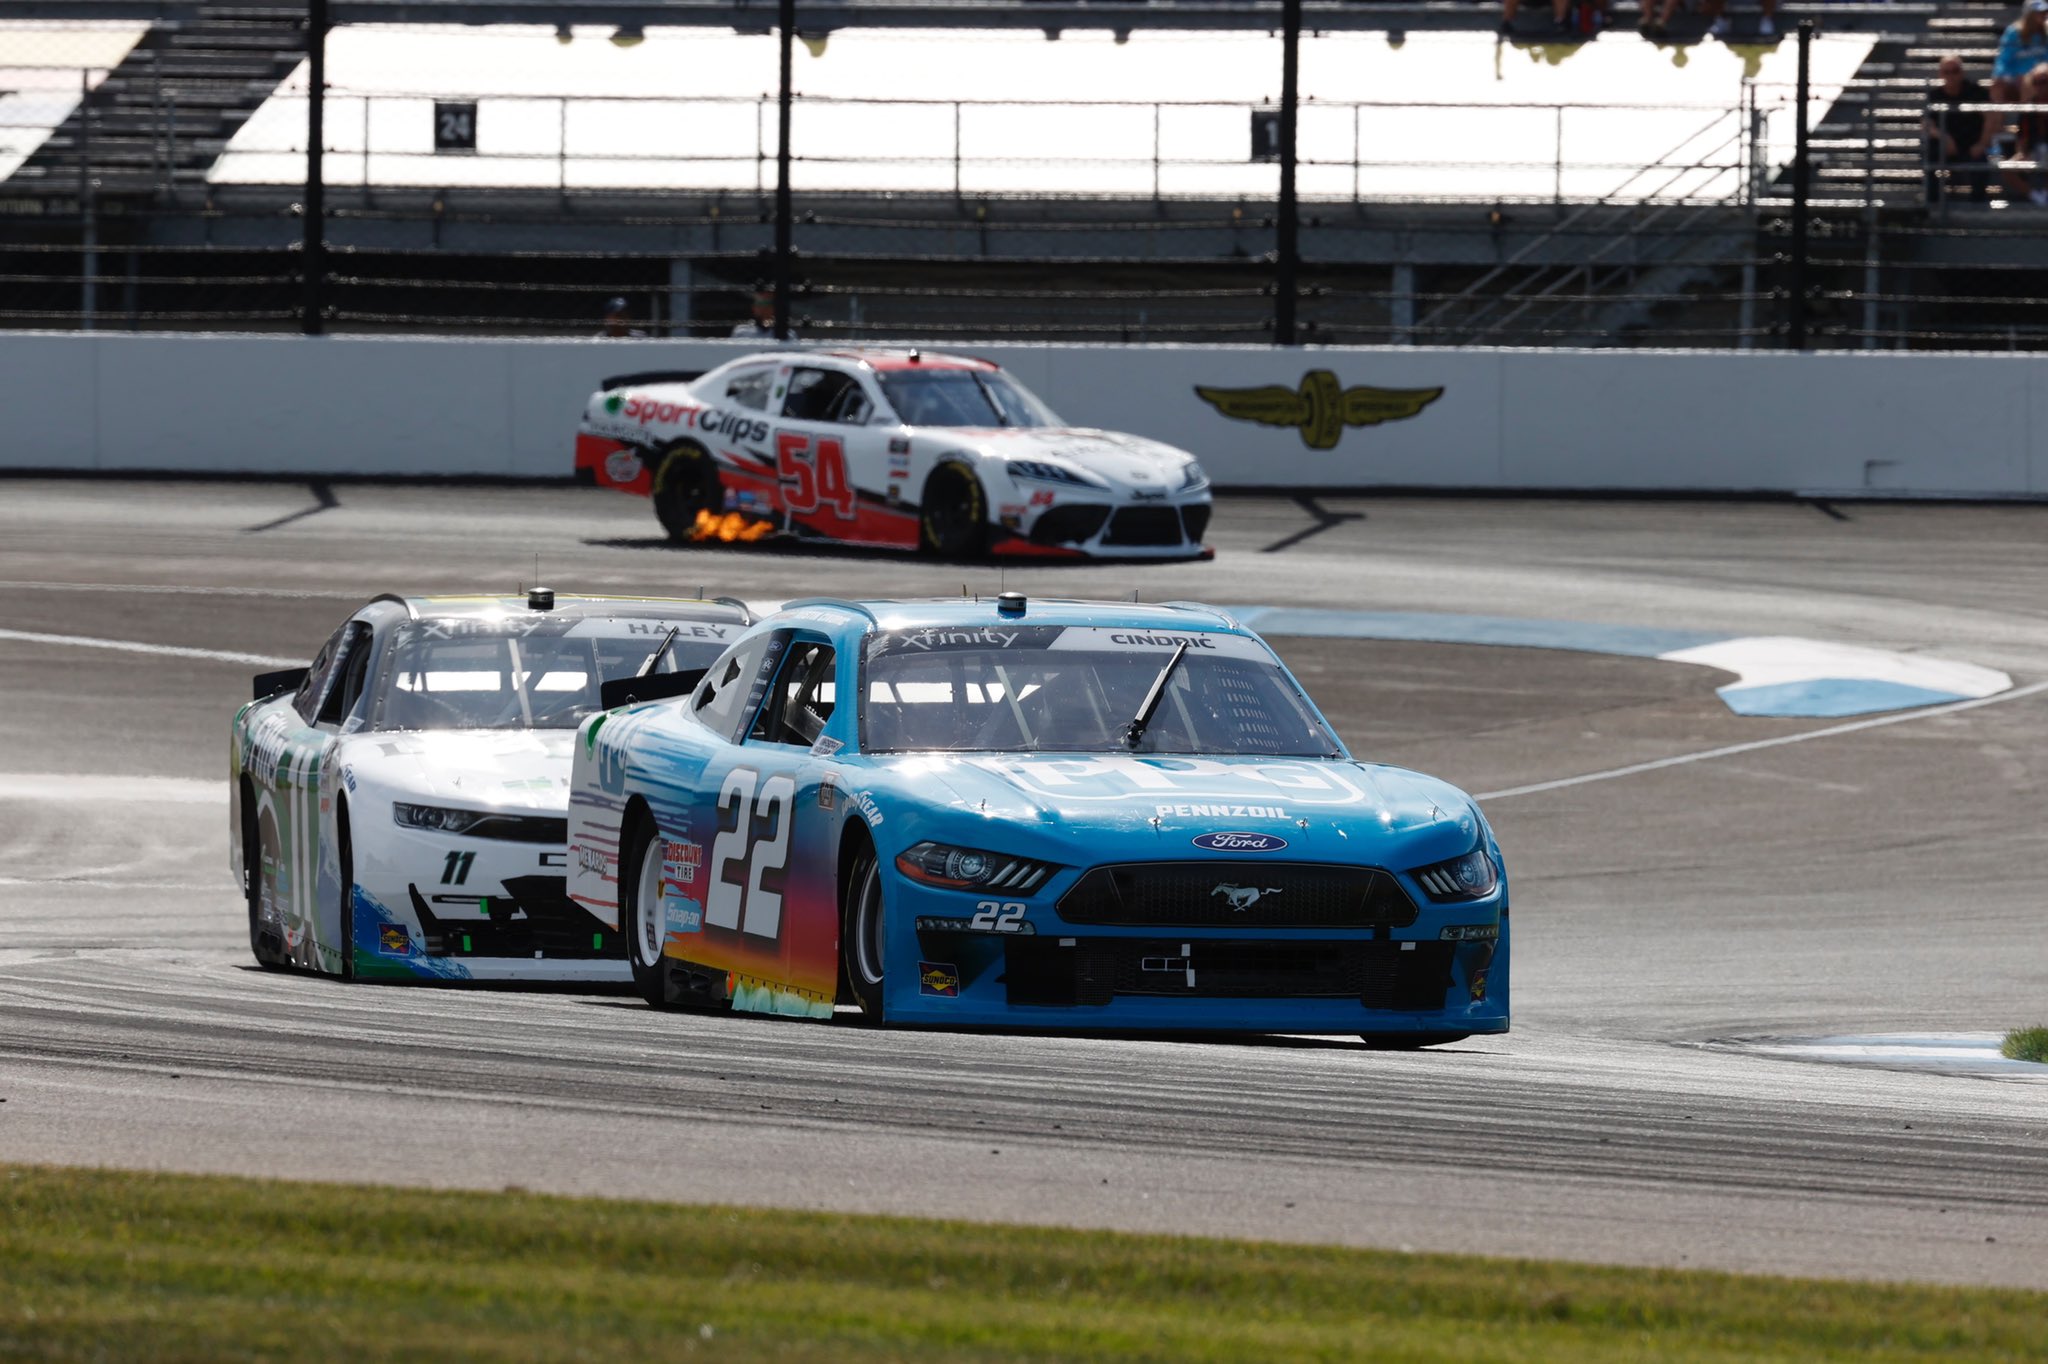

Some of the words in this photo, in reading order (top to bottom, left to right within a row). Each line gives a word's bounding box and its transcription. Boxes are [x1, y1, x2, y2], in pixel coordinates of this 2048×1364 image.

[440, 112, 470, 140] 24
[777, 431, 855, 520] 54
[627, 622, 727, 640] HALEY
[900, 630, 1020, 650] xfinity
[1110, 633, 1217, 649] CINDRIC
[1012, 757, 1333, 791] PPG
[1155, 804, 1293, 819] PENNZOIL
[667, 841, 702, 868] DISCOUNT
[704, 768, 796, 940] 22
[1210, 832, 1269, 851] Ford
[440, 851, 478, 886] 11
[677, 865, 692, 880] TIRE
[667, 902, 700, 928] Snap-on
[970, 901, 1027, 932] 22
[923, 975, 956, 985] SUNOCO
